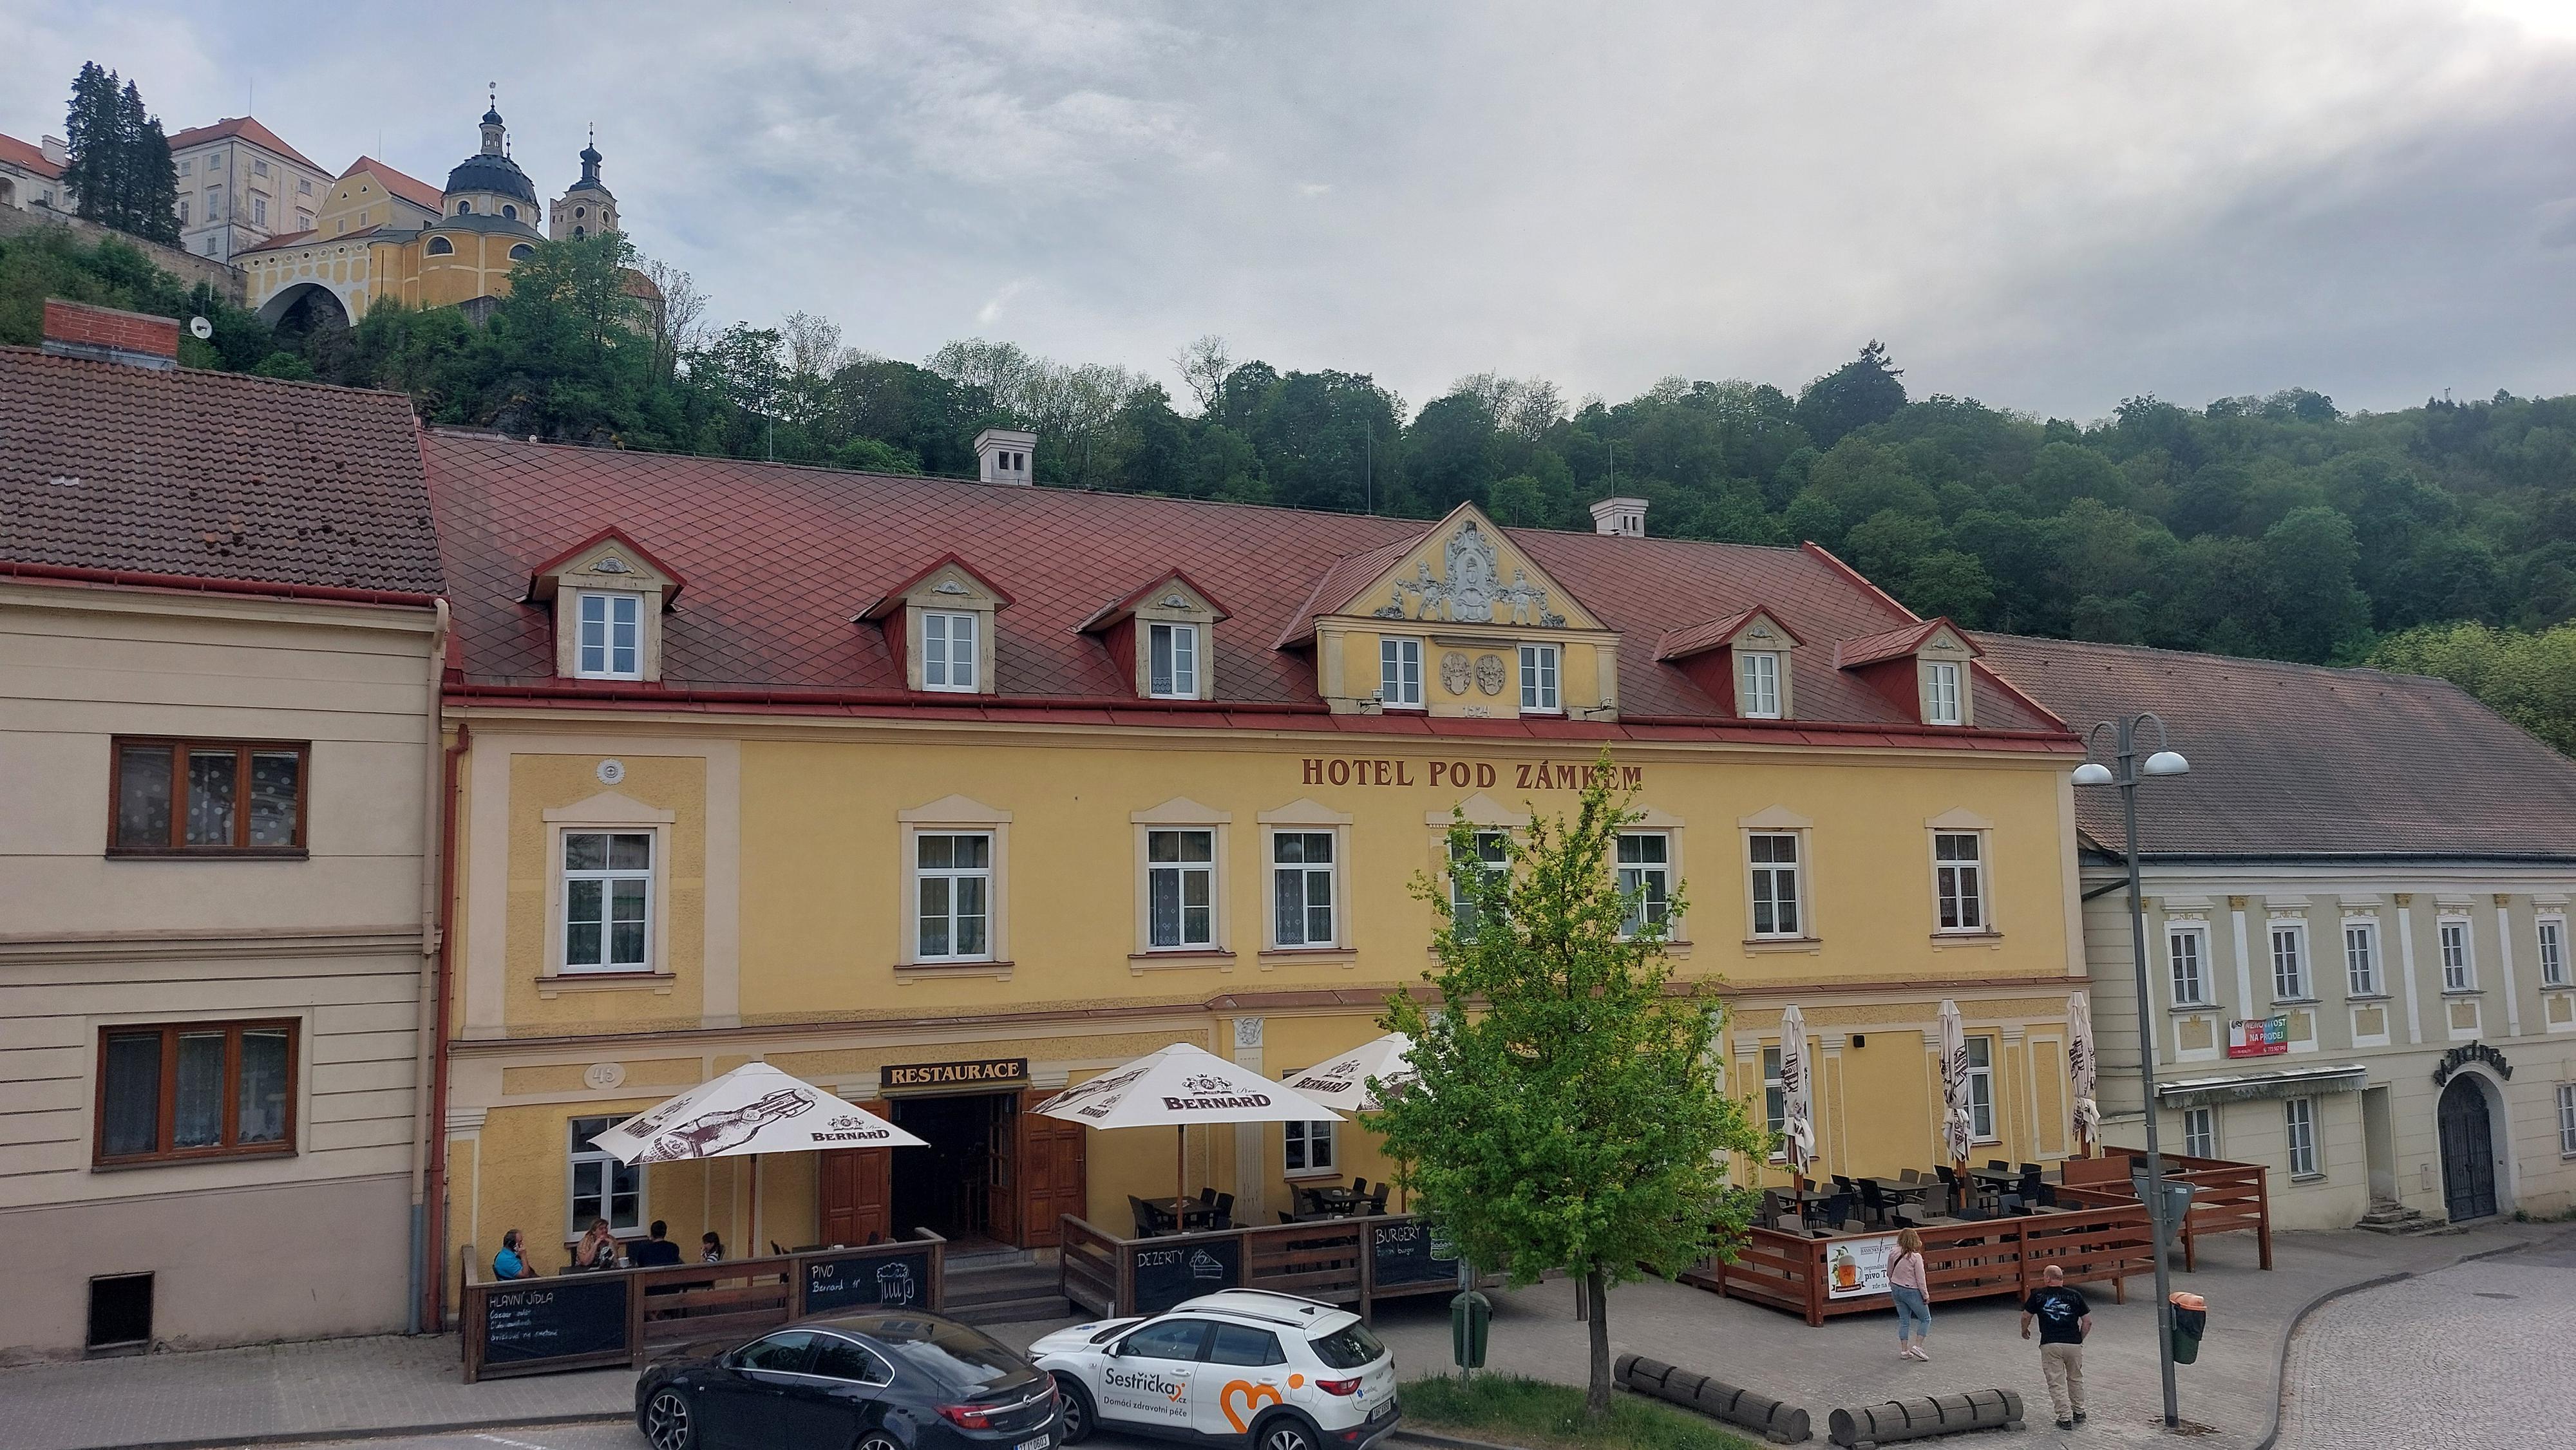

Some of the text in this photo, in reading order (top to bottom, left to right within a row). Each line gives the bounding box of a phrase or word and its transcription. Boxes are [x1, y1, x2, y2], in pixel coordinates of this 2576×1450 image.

[1302, 758, 1643, 791] HOTEL POD ZÁMKEM
[2245, 1019, 2287, 1030] NEMOVITOST
[2250, 1031, 2284, 1042] NA PRODEJ
[593, 1068, 616, 1084] 45
[891, 1062, 1020, 1084] RESTAURACE
[1291, 1077, 1352, 1093] BERNARD
[1160, 1094, 1271, 1111] BERNARD
[811, 1129, 891, 1142] BERNARD
[1375, 1225, 1421, 1245] BURGERY
[1137, 1249, 1185, 1267] DEZERTY
[811, 1265, 834, 1279] PIVO
[1865, 1270, 1880, 1282] pivo
[811, 1279, 844, 1293] Bernard
[489, 1290, 554, 1308] HLAVNÍ JÍDLA
[1105, 1368, 1176, 1395] Sestřička
[1103, 1396, 1187, 1417] Domácí zdravotní péče
[1033, 1436, 1047, 1450] 0603
